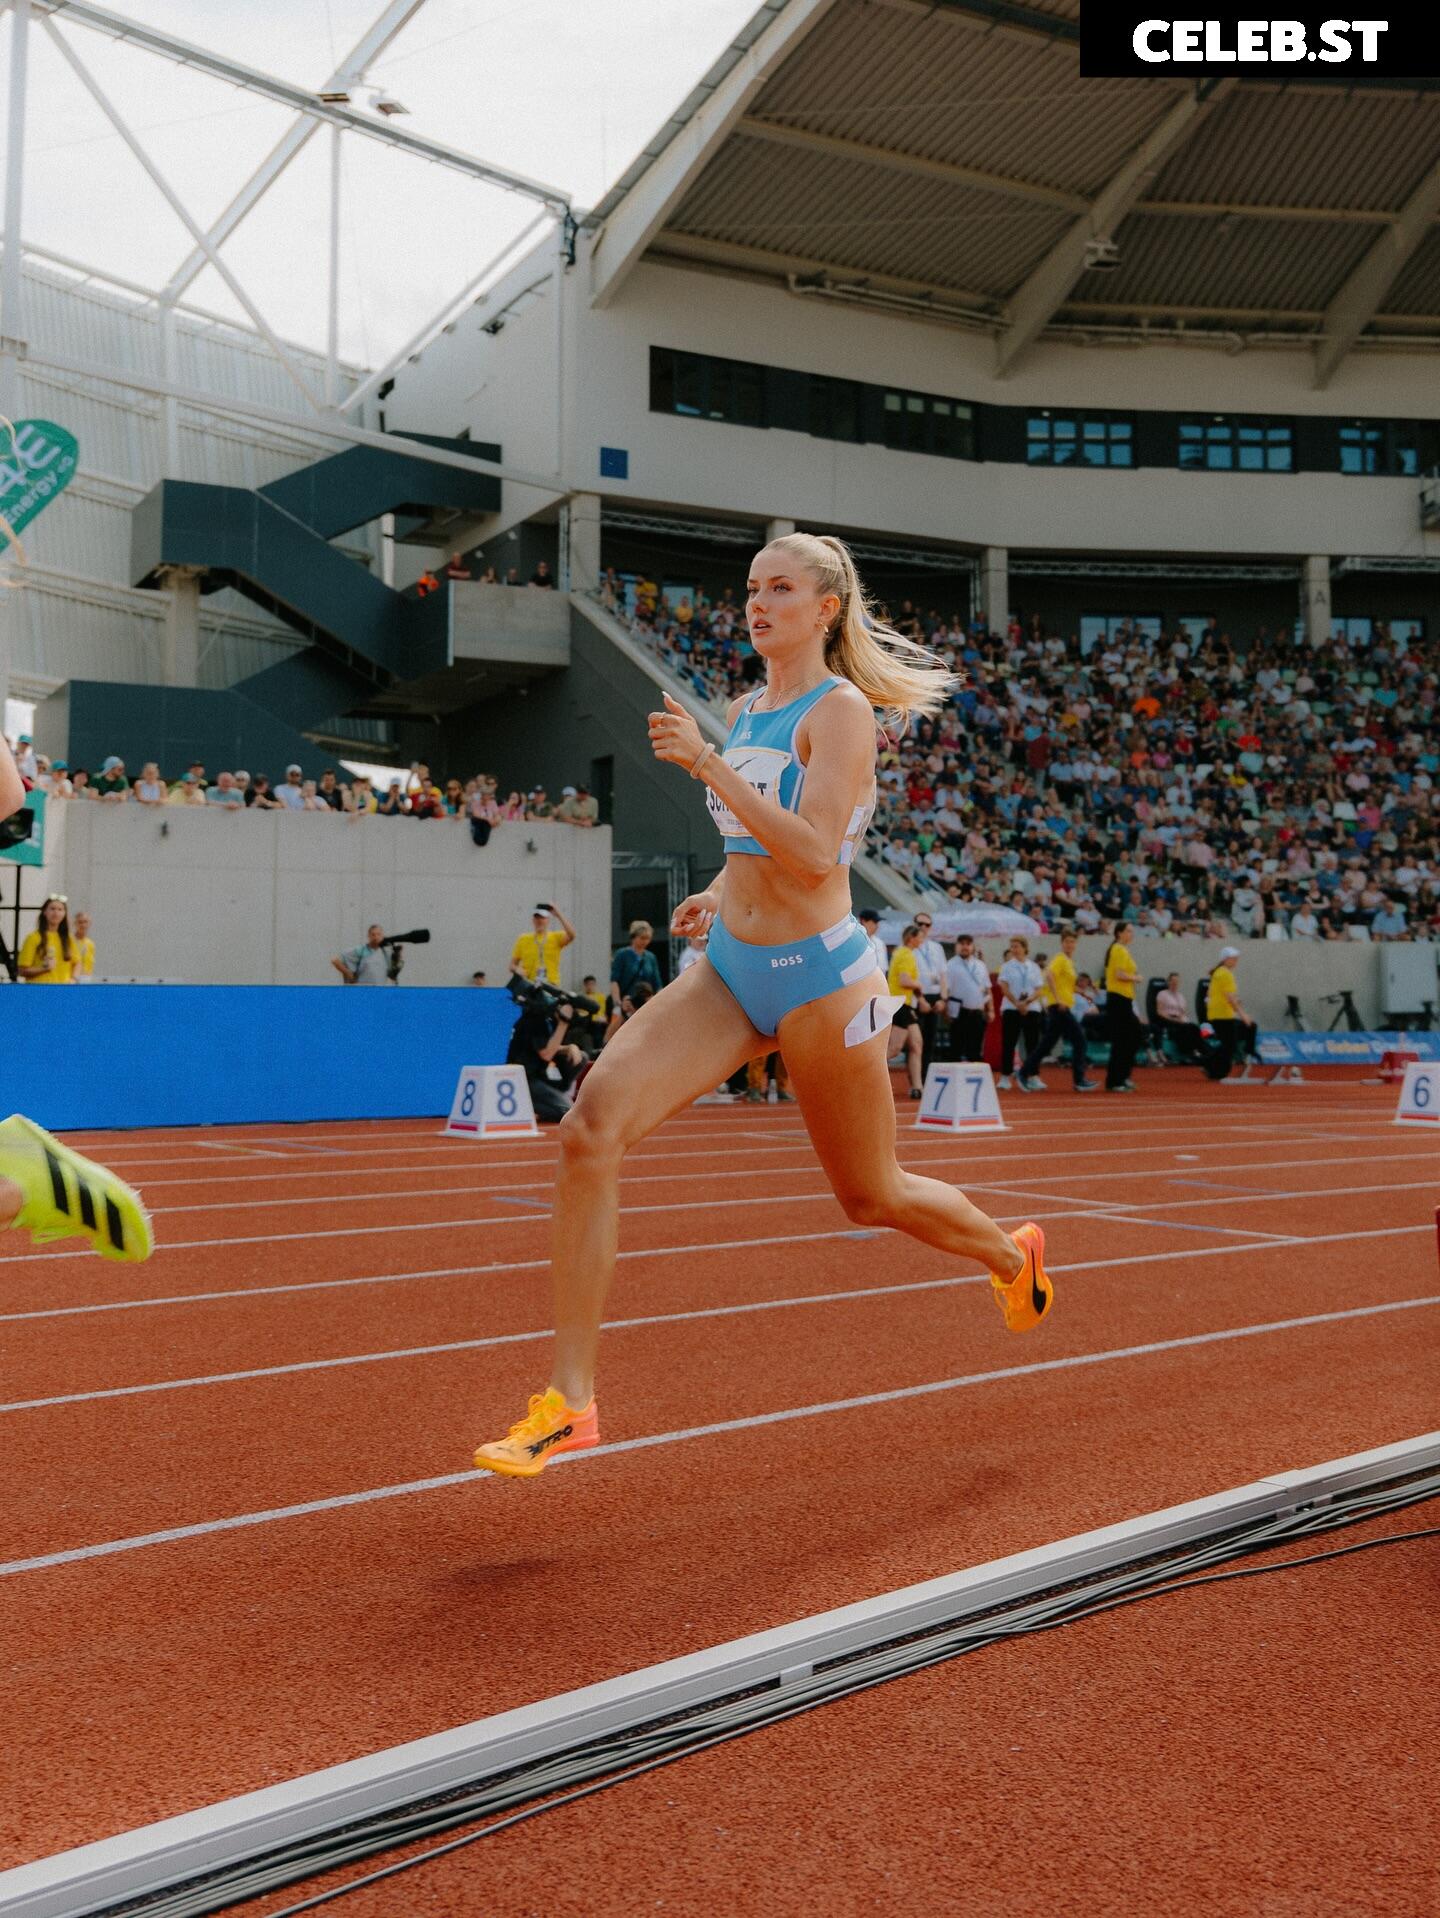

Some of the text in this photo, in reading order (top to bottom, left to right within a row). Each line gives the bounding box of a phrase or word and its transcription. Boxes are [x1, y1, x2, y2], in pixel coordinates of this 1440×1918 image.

[770, 954, 804, 968] BOSS
[461, 1080, 476, 1117] 8
[497, 1080, 517, 1117] 8
[934, 1076, 950, 1112] 7
[965, 1076, 984, 1112] 7
[1414, 1076, 1430, 1108] 6
